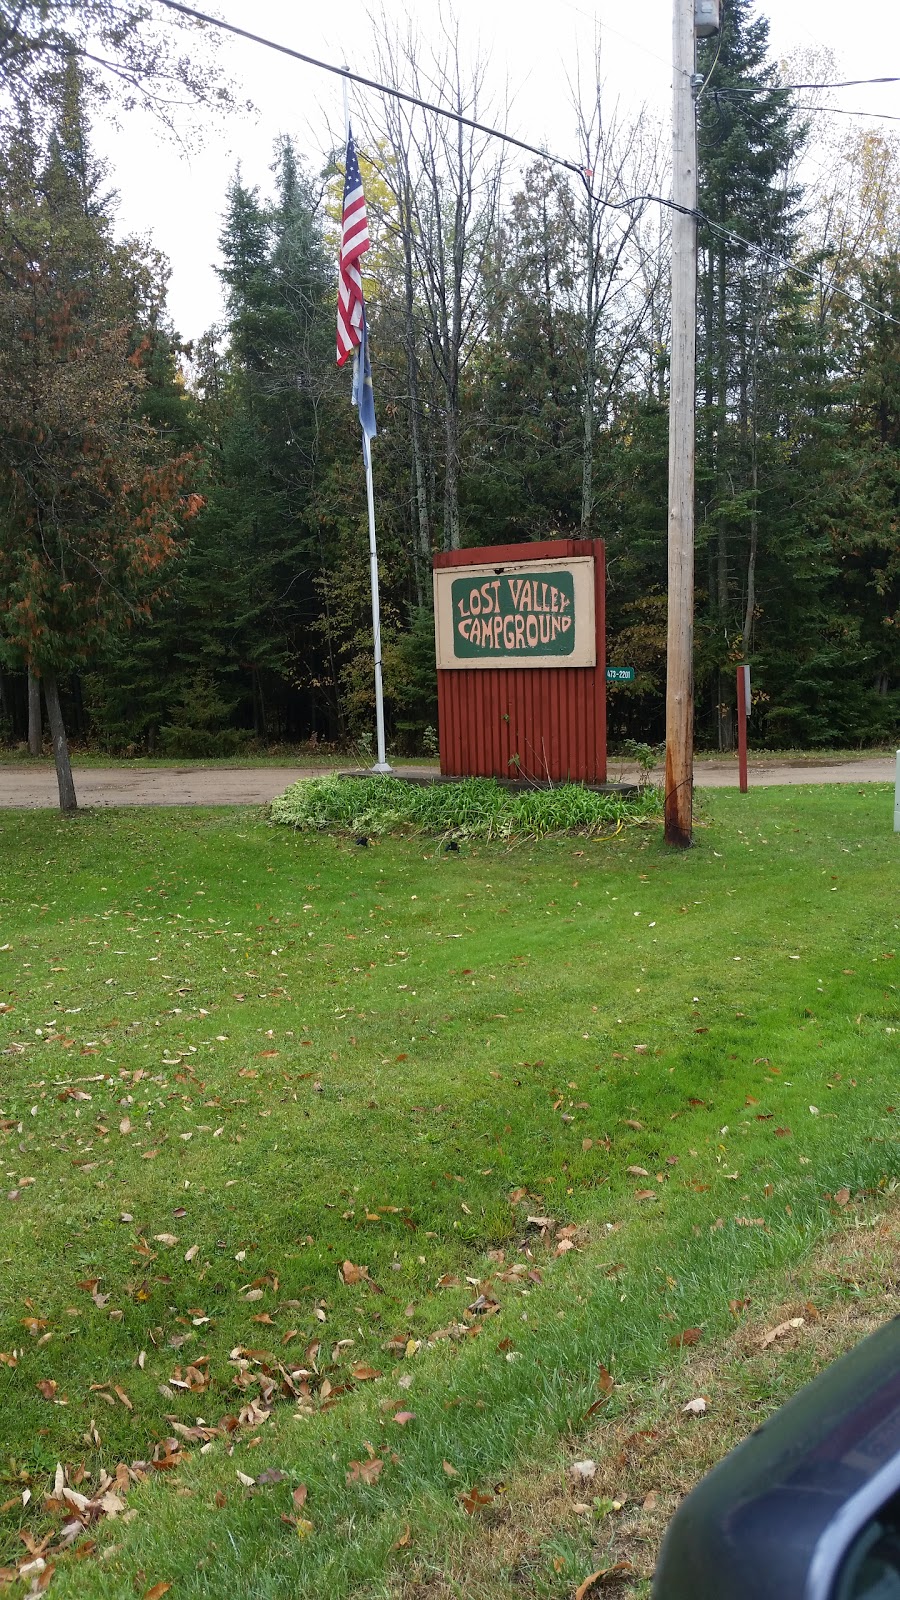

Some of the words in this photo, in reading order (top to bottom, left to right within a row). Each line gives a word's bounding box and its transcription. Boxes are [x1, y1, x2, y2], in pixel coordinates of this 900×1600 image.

[457, 580, 501, 617] LOST
[508, 579, 571, 613] VALLEY
[457, 614, 573, 649] CAMPGROUND
